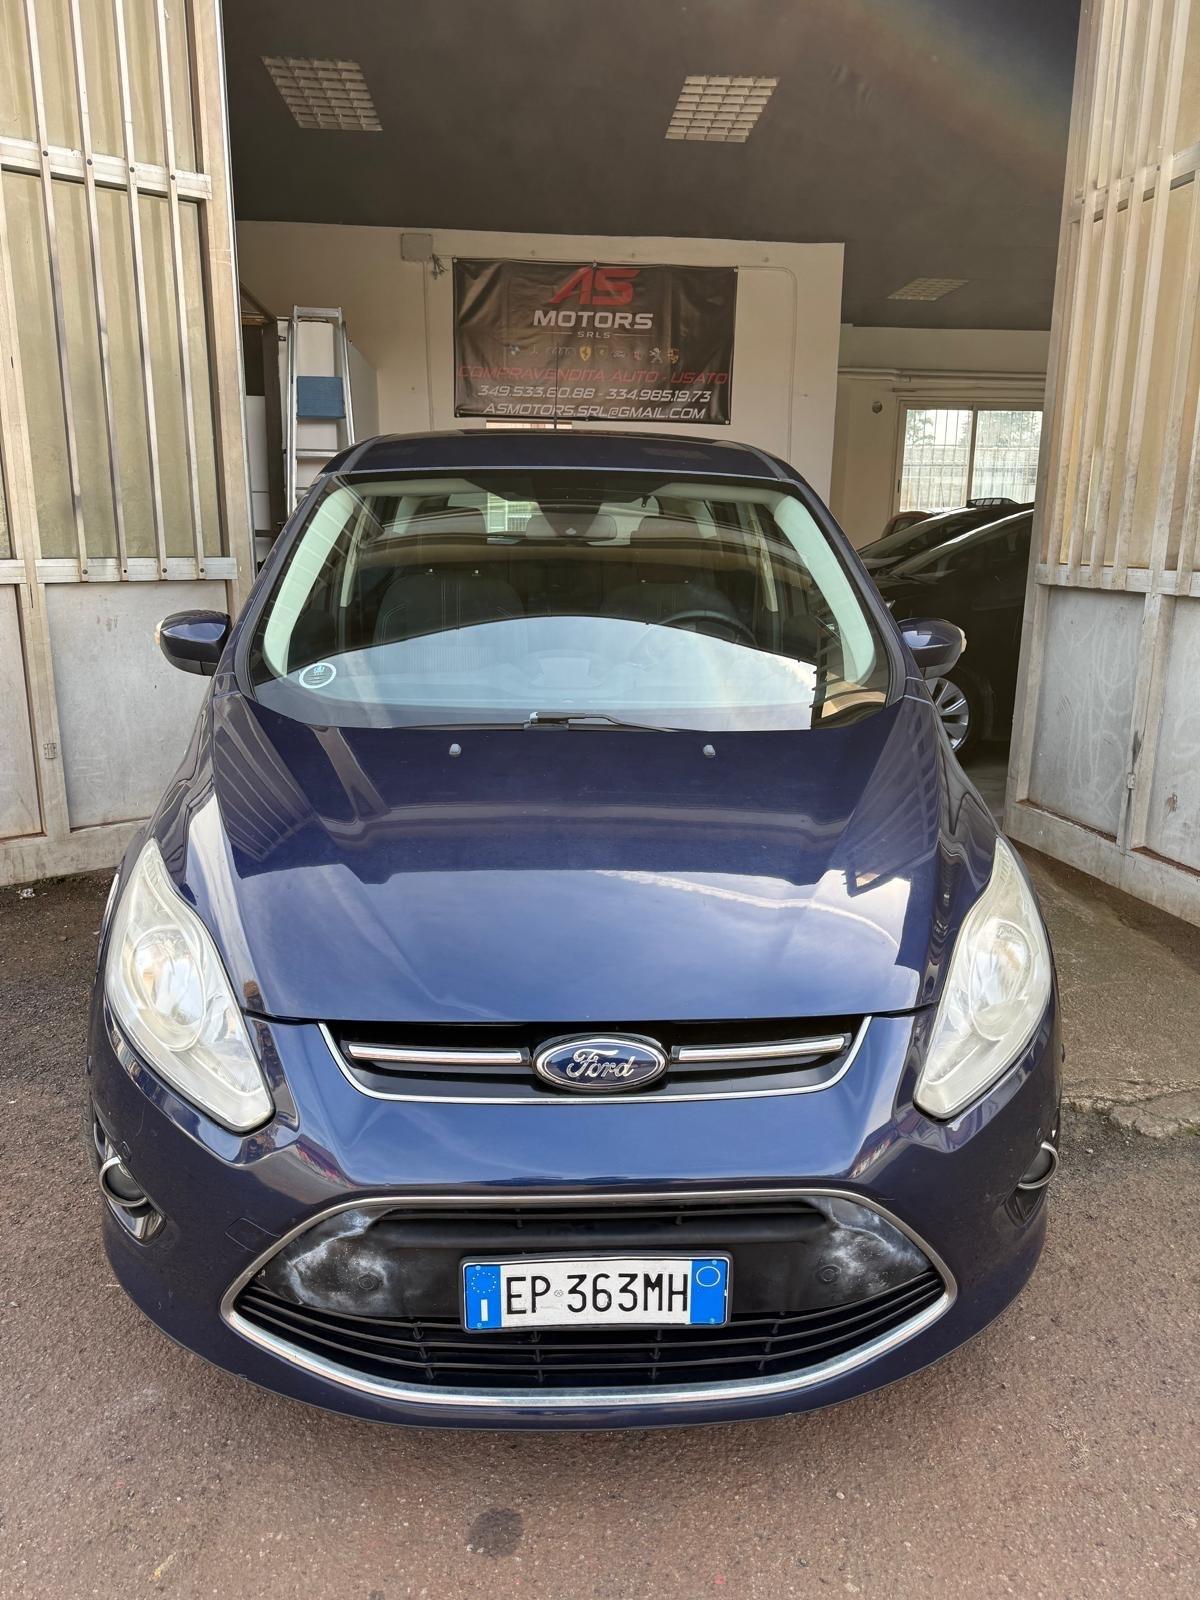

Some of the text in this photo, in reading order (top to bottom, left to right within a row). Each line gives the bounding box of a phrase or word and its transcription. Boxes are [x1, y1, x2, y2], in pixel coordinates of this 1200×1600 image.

[548, 265, 640, 306] AS
[533, 310, 654, 329] MOTORS
[577, 331, 611, 339] SRLS
[458, 366, 605, 381] COMPRAVENDITA
[611, 369, 658, 383] AUTO
[671, 371, 728, 384] USATO
[478, 385, 595, 399] 349.533.60.88
[606, 388, 712, 402] 334.985.19.73
[483, 403, 706, 419] ASMOTORS.SRL@GMAIL.COM
[566, 1048, 635, 1078] Ford
[506, 1275, 551, 1315] EP
[566, 1272, 689, 1313] 363MH
